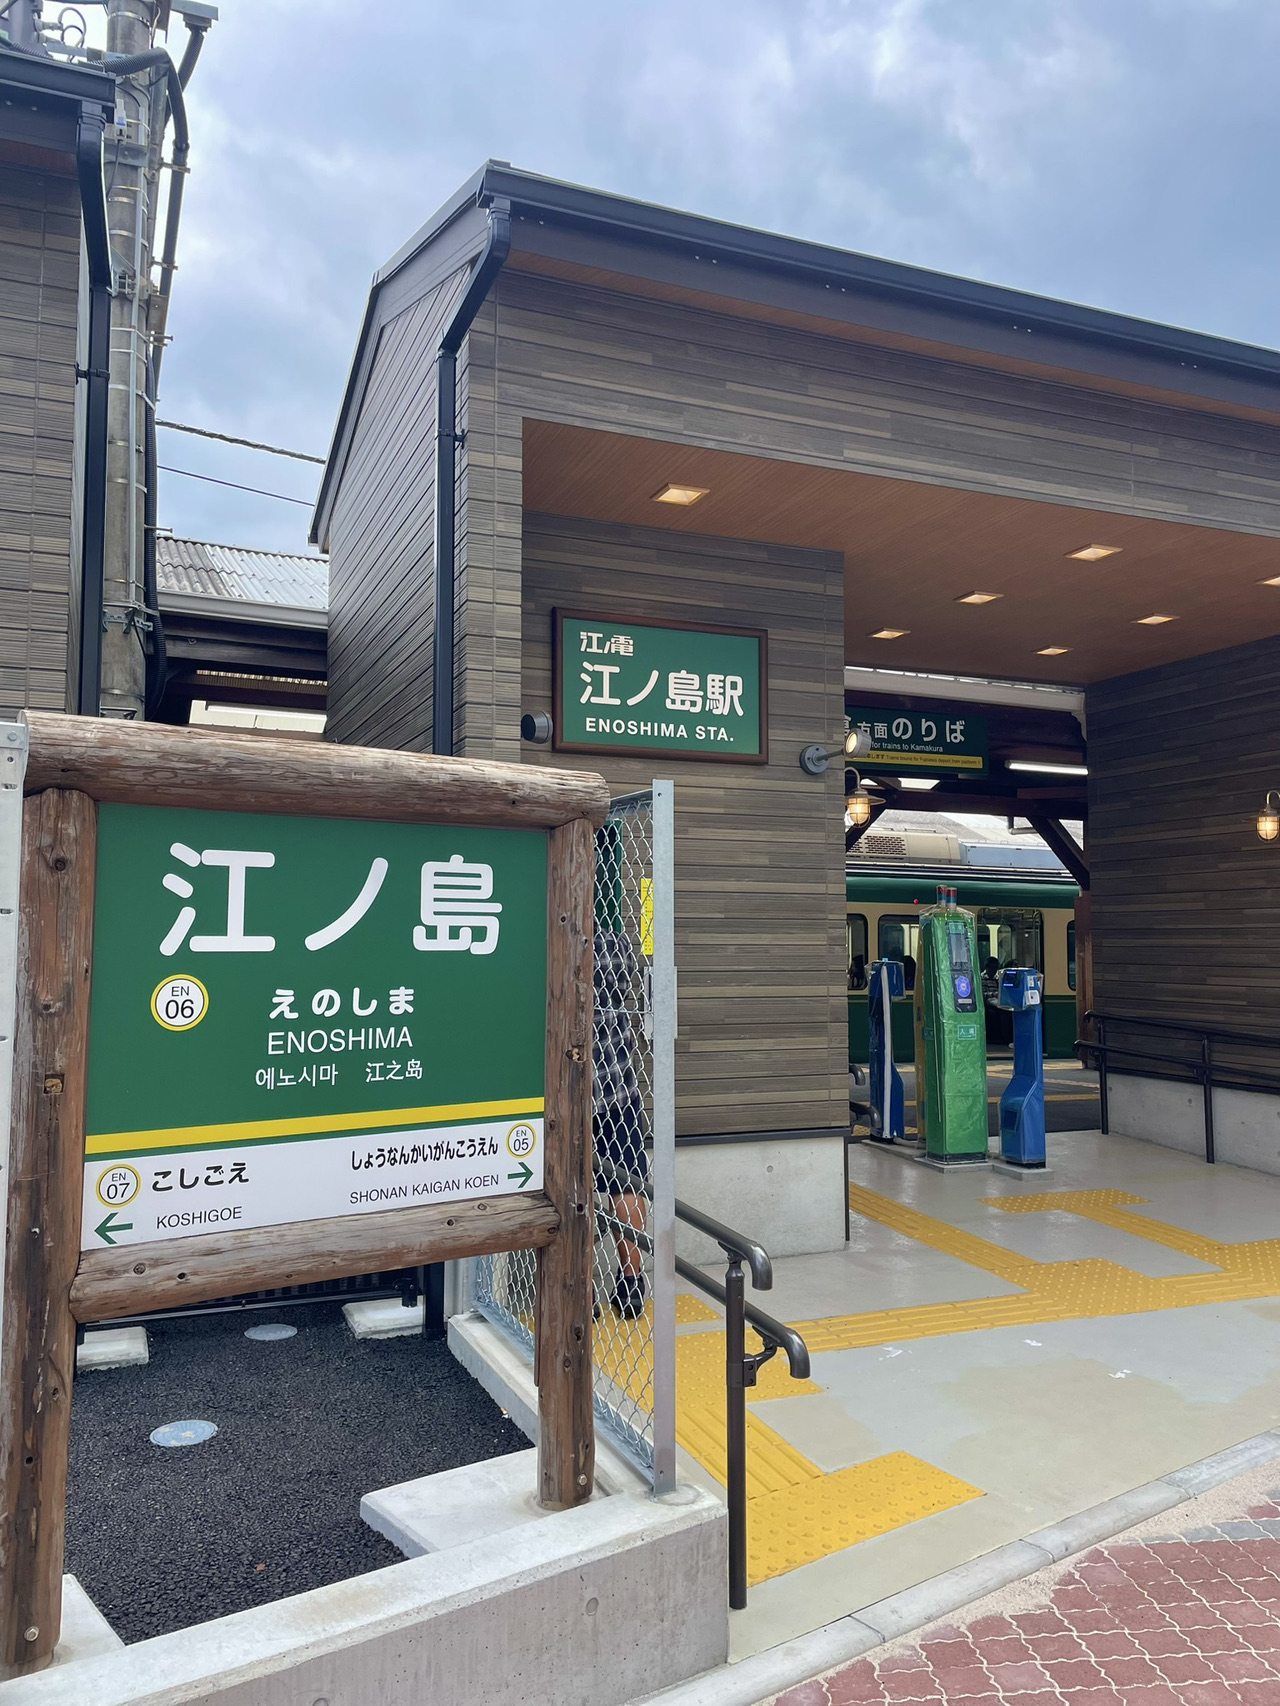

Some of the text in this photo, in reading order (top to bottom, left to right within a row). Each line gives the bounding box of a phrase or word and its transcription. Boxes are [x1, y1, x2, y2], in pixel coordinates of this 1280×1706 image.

[580, 661, 744, 717] 江ノ島駅
[585, 717, 734, 742] ENOSHIMA STA.
[882, 742, 901, 750] trains
[910, 743, 943, 753] Kamakura
[160, 843, 503, 957] 江ノ島
[171, 985, 190, 997] EN
[269, 986, 415, 1020] えのしま
[164, 998, 195, 1020] 06
[267, 1026, 413, 1056] ENOSHIMA
[255, 1063, 338, 1090] 에노시마
[365, 1058, 423, 1083] 江之岛
[513, 1137, 530, 1152] 05
[515, 1129, 527, 1138] EN
[350, 1135, 499, 1171] しょうなんかいがんこうえん
[111, 1172, 127, 1182] EN
[152, 1162, 250, 1192] こしごえ
[349, 1173, 500, 1205] SHONAN KAIGAN KOEN
[106, 1182, 131, 1201] 07
[155, 1205, 243, 1229] KOSHIGOE
